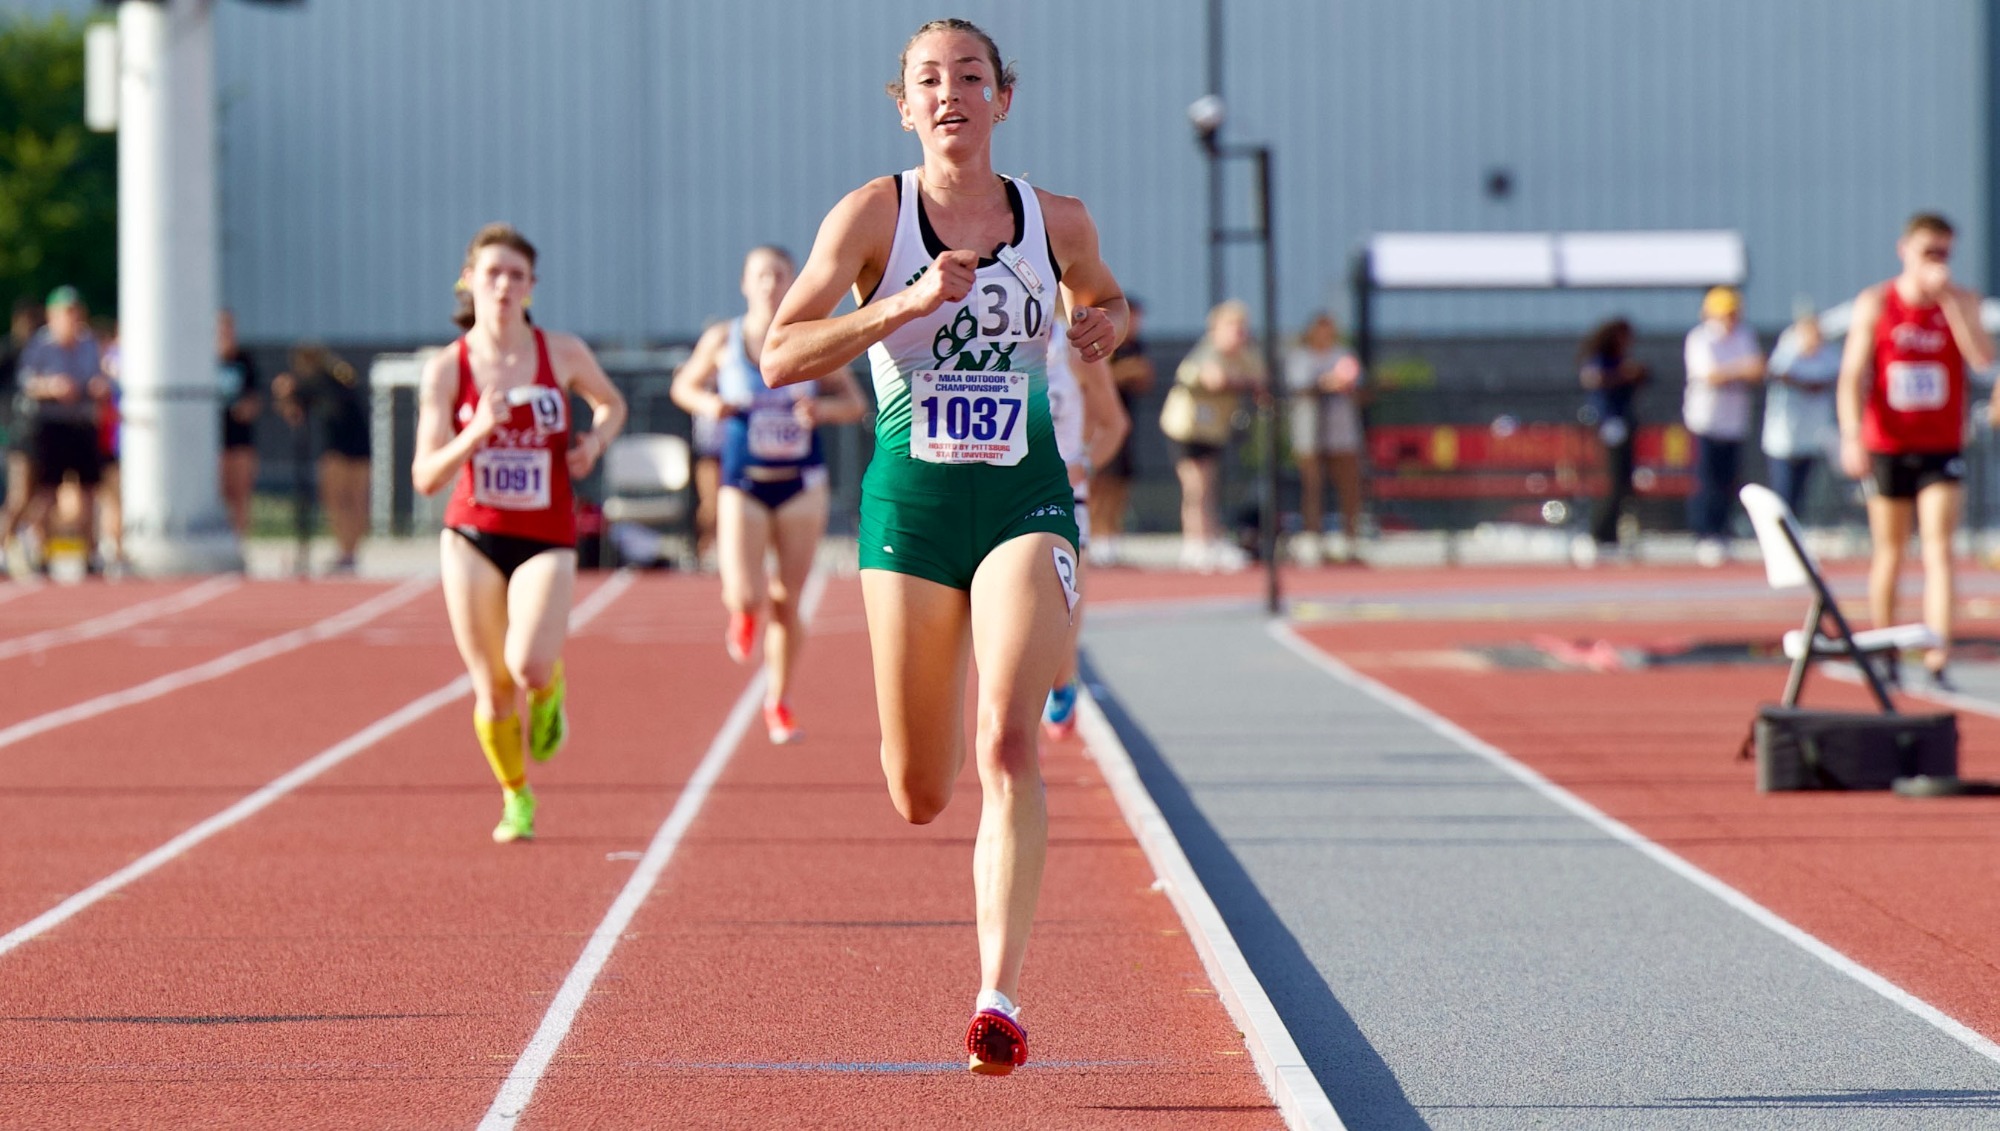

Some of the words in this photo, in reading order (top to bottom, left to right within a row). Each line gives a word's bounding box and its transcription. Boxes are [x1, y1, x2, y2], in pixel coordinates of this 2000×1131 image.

[981, 284, 1010, 337] 3
[935, 383, 1009, 393] CHAMPIONSHIPS
[938, 374, 963, 383] MIAA
[965, 374, 1006, 384] OUTDOOR
[539, 396, 558, 426] 9
[921, 396, 1022, 441] 1037
[928, 442, 957, 451] HOSTED
[971, 444, 1011, 452] PITTSBURG
[936, 451, 958, 459] STATE
[961, 452, 1004, 460] UNIVERSITY
[482, 465, 541, 491] 1091
